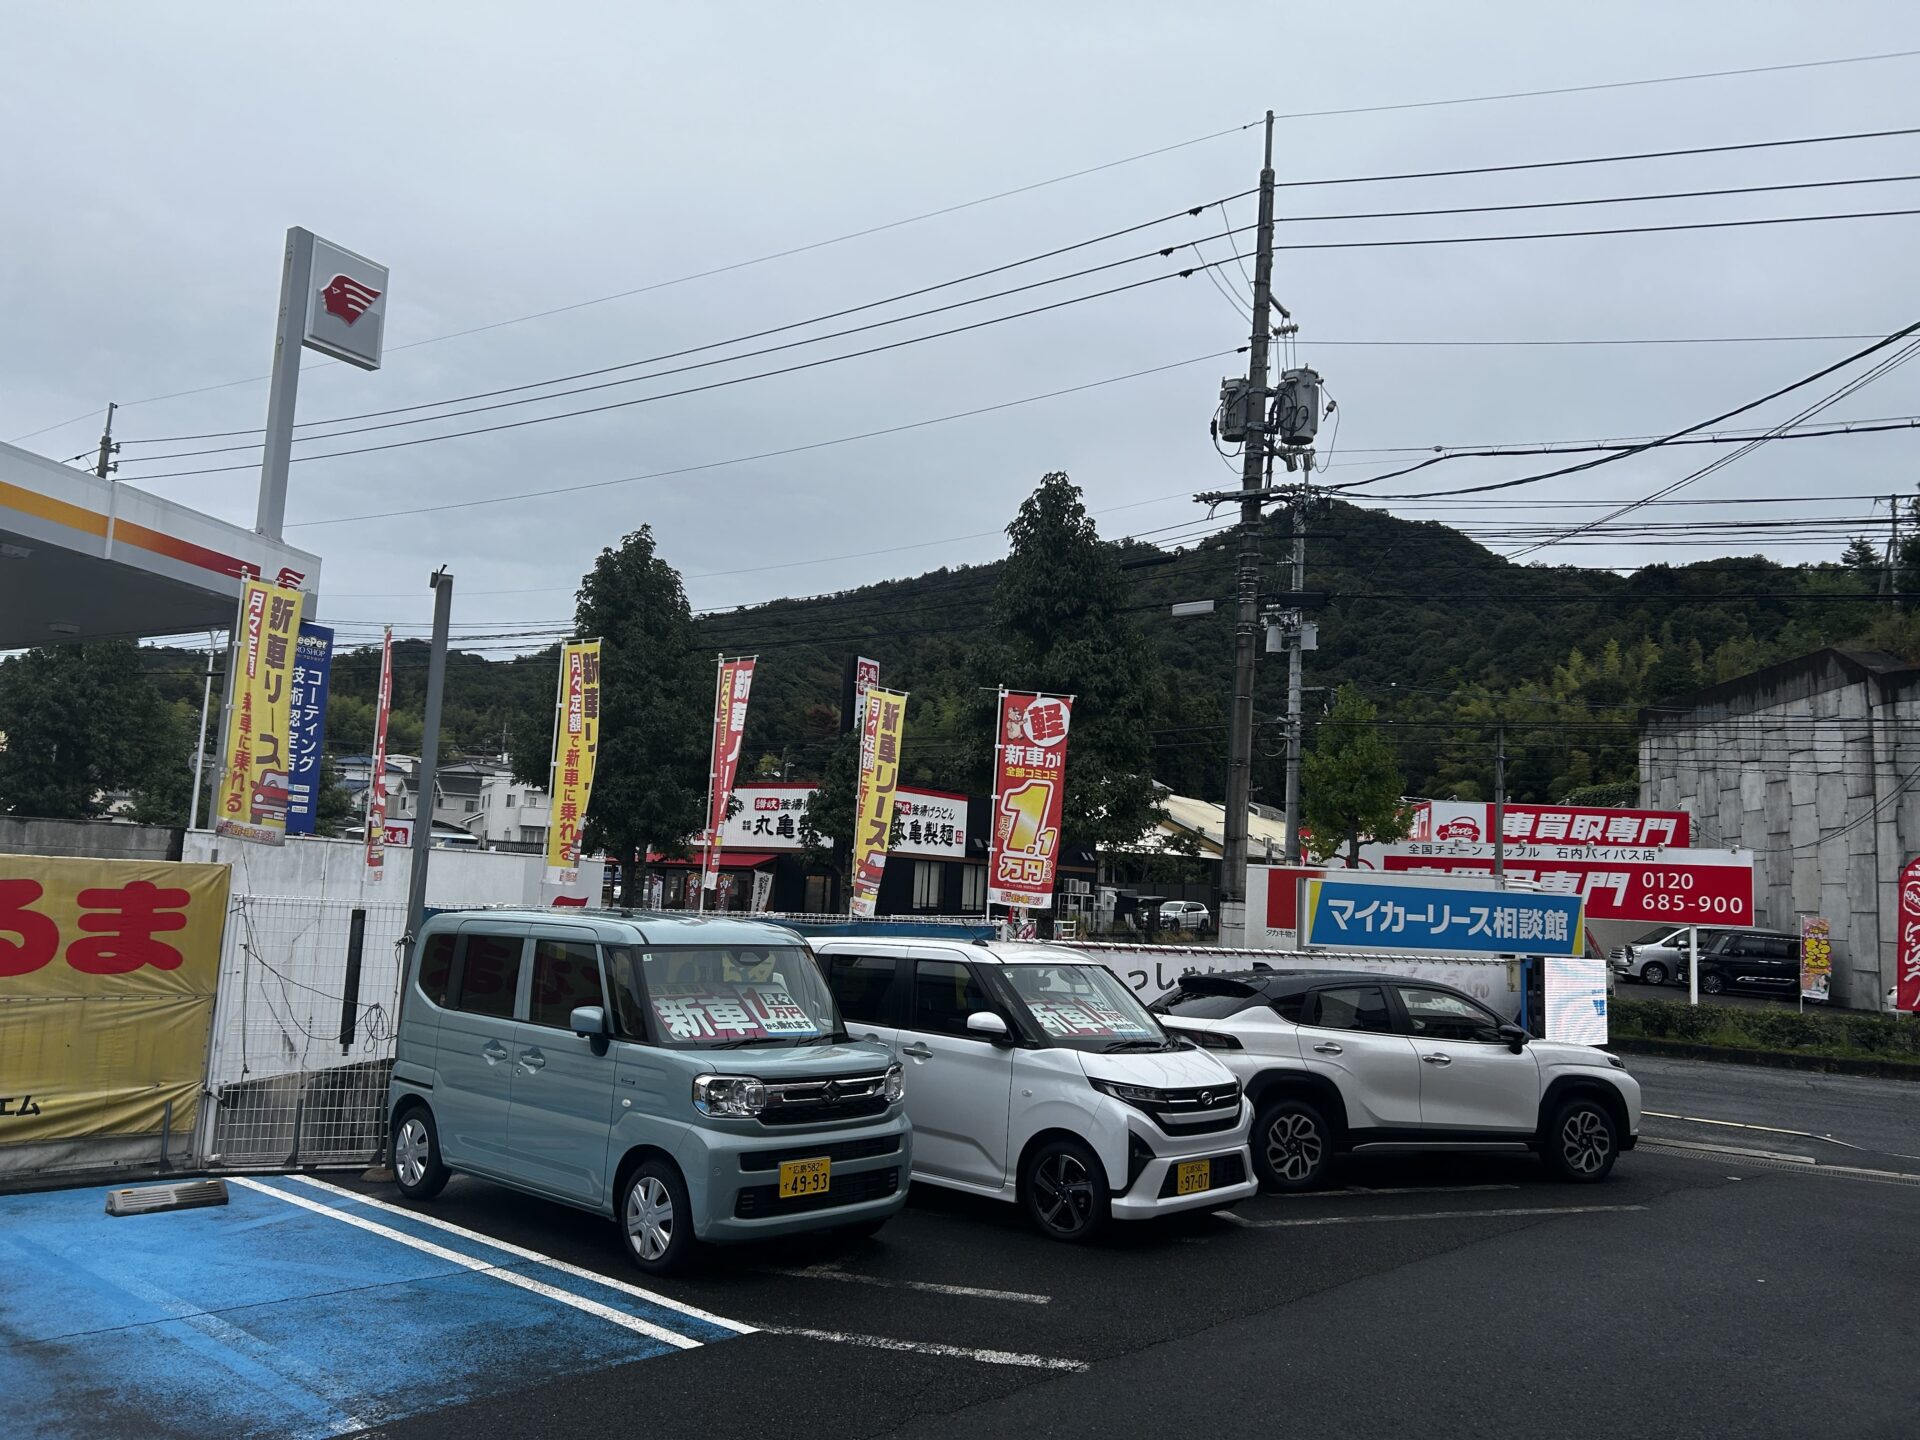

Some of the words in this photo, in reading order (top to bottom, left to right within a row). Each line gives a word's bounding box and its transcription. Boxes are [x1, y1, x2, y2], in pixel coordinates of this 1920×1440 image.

[297, 636, 327, 649] eePer
[306, 647, 326, 657] SHOP
[299, 669, 322, 772] コーティング
[1028, 703, 1066, 740] 軽
[1004, 744, 1061, 769] 新車が
[865, 701, 900, 849] 新車リース
[1005, 767, 1058, 780] 全部コミコミ
[911, 803, 956, 820] 釜揚げうどん
[1502, 812, 1678, 845] 車買取専門
[1408, 843, 1483, 857] 全国チェーン
[1556, 847, 1656, 862] 石内バイパス店
[1000, 855, 1045, 882] 万円
[1642, 871, 1694, 890] 0120
[1642, 893, 1743, 914] 685-900
[1327, 899, 1568, 942] マイカーリース相談館
[762, 993, 792, 1006] 月々
[652, 997, 759, 1038] 新車
[773, 1006, 807, 1020] 万円
[1027, 1002, 1105, 1034] 新車
[807, 1162, 820, 1172] 582
[791, 1172, 828, 1194] 49-93
[1185, 1172, 1209, 1191] 97-07
